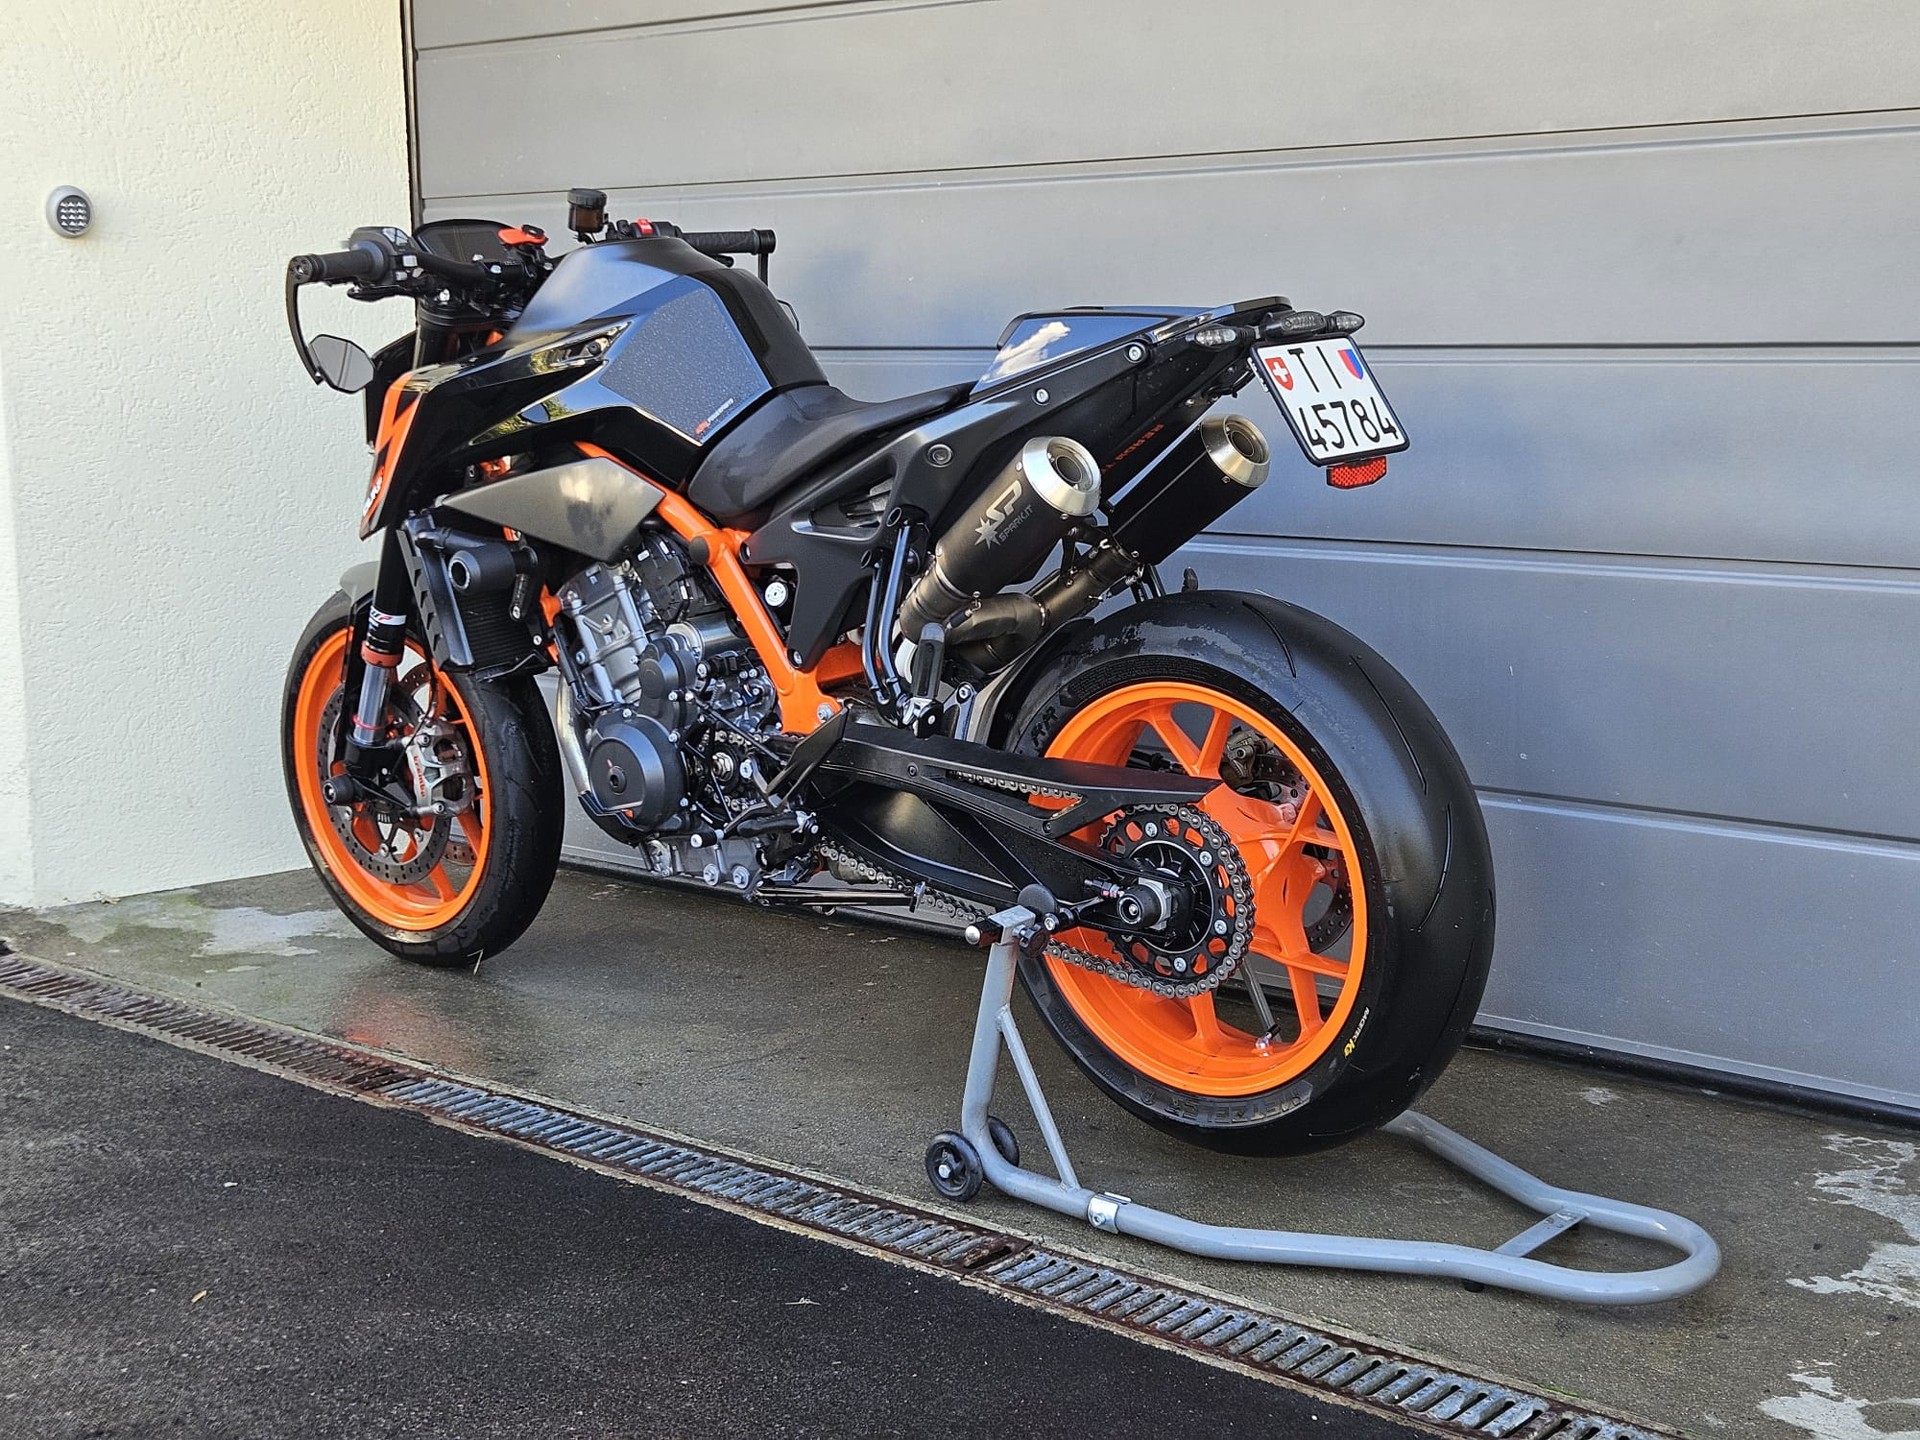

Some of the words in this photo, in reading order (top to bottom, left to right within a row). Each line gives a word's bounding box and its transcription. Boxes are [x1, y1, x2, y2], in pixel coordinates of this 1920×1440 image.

[1287, 346, 1342, 393] TI
[1299, 397, 1399, 451] 45784
[413, 755, 425, 798] brembo
